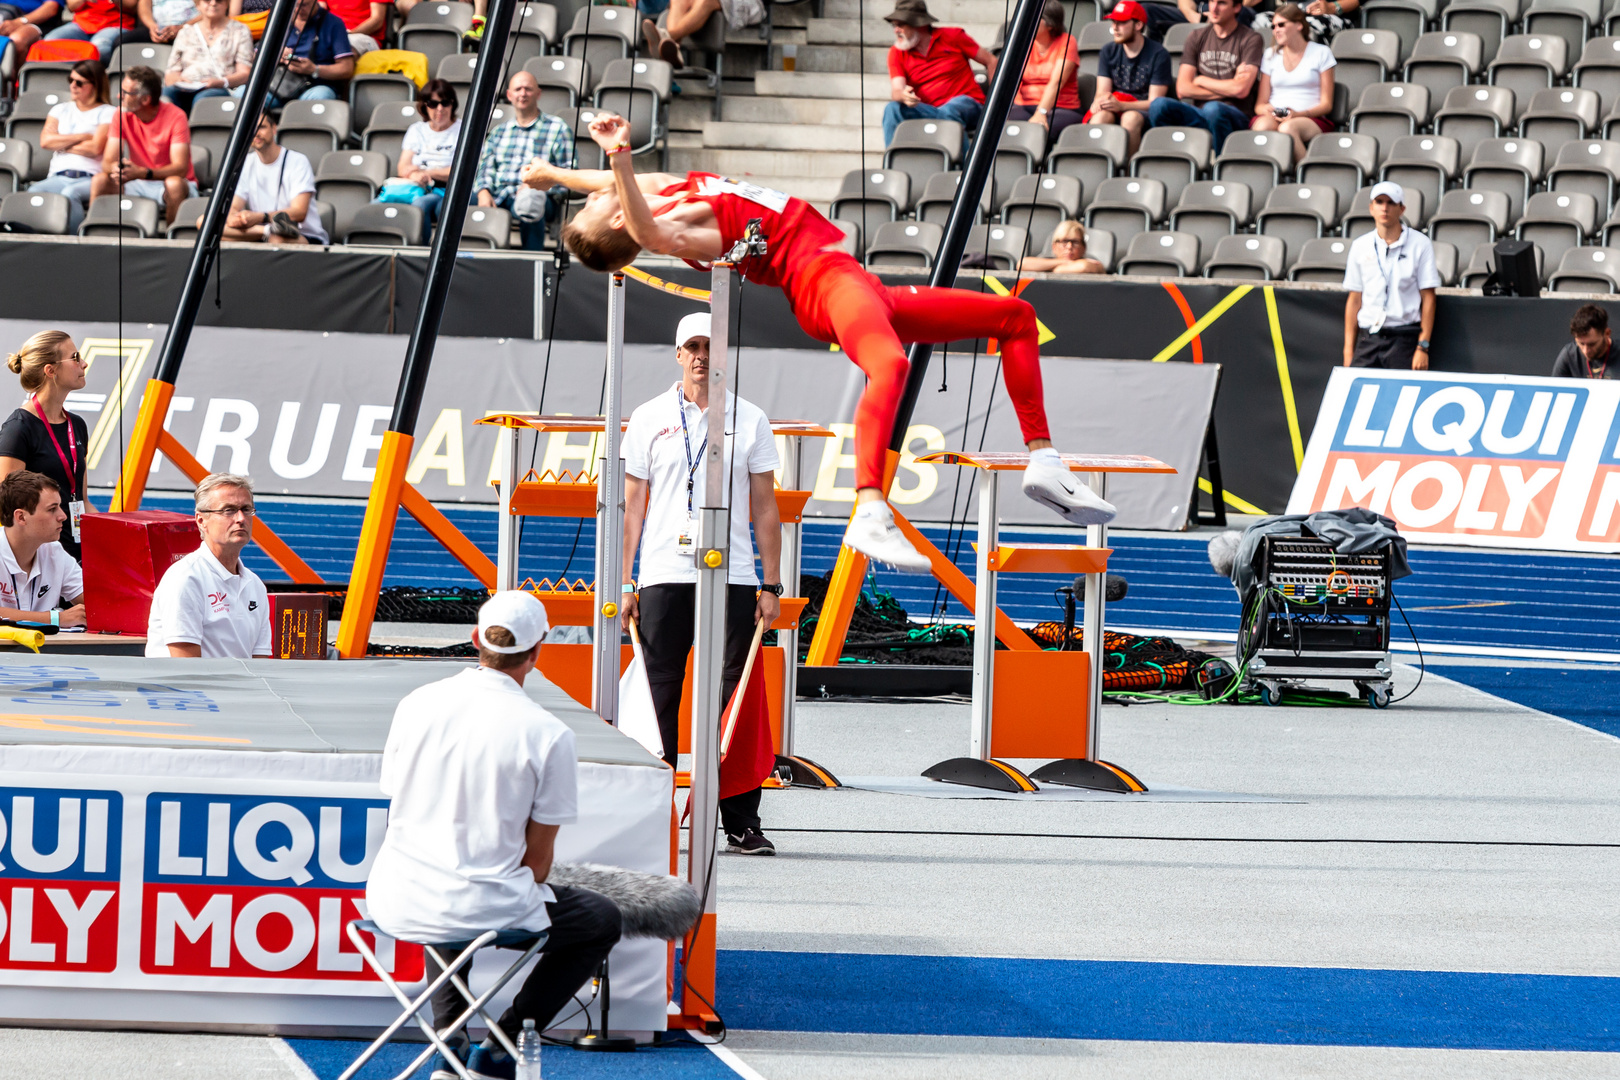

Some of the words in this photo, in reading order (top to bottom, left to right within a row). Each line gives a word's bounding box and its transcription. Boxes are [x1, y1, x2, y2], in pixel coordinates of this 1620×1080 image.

[1343, 384, 1577, 456] LIQUI
[1320, 458, 1561, 532] MOLY
[0, 796, 109, 873] UI
[158, 801, 388, 886] LIQU
[0, 887, 116, 963] LY
